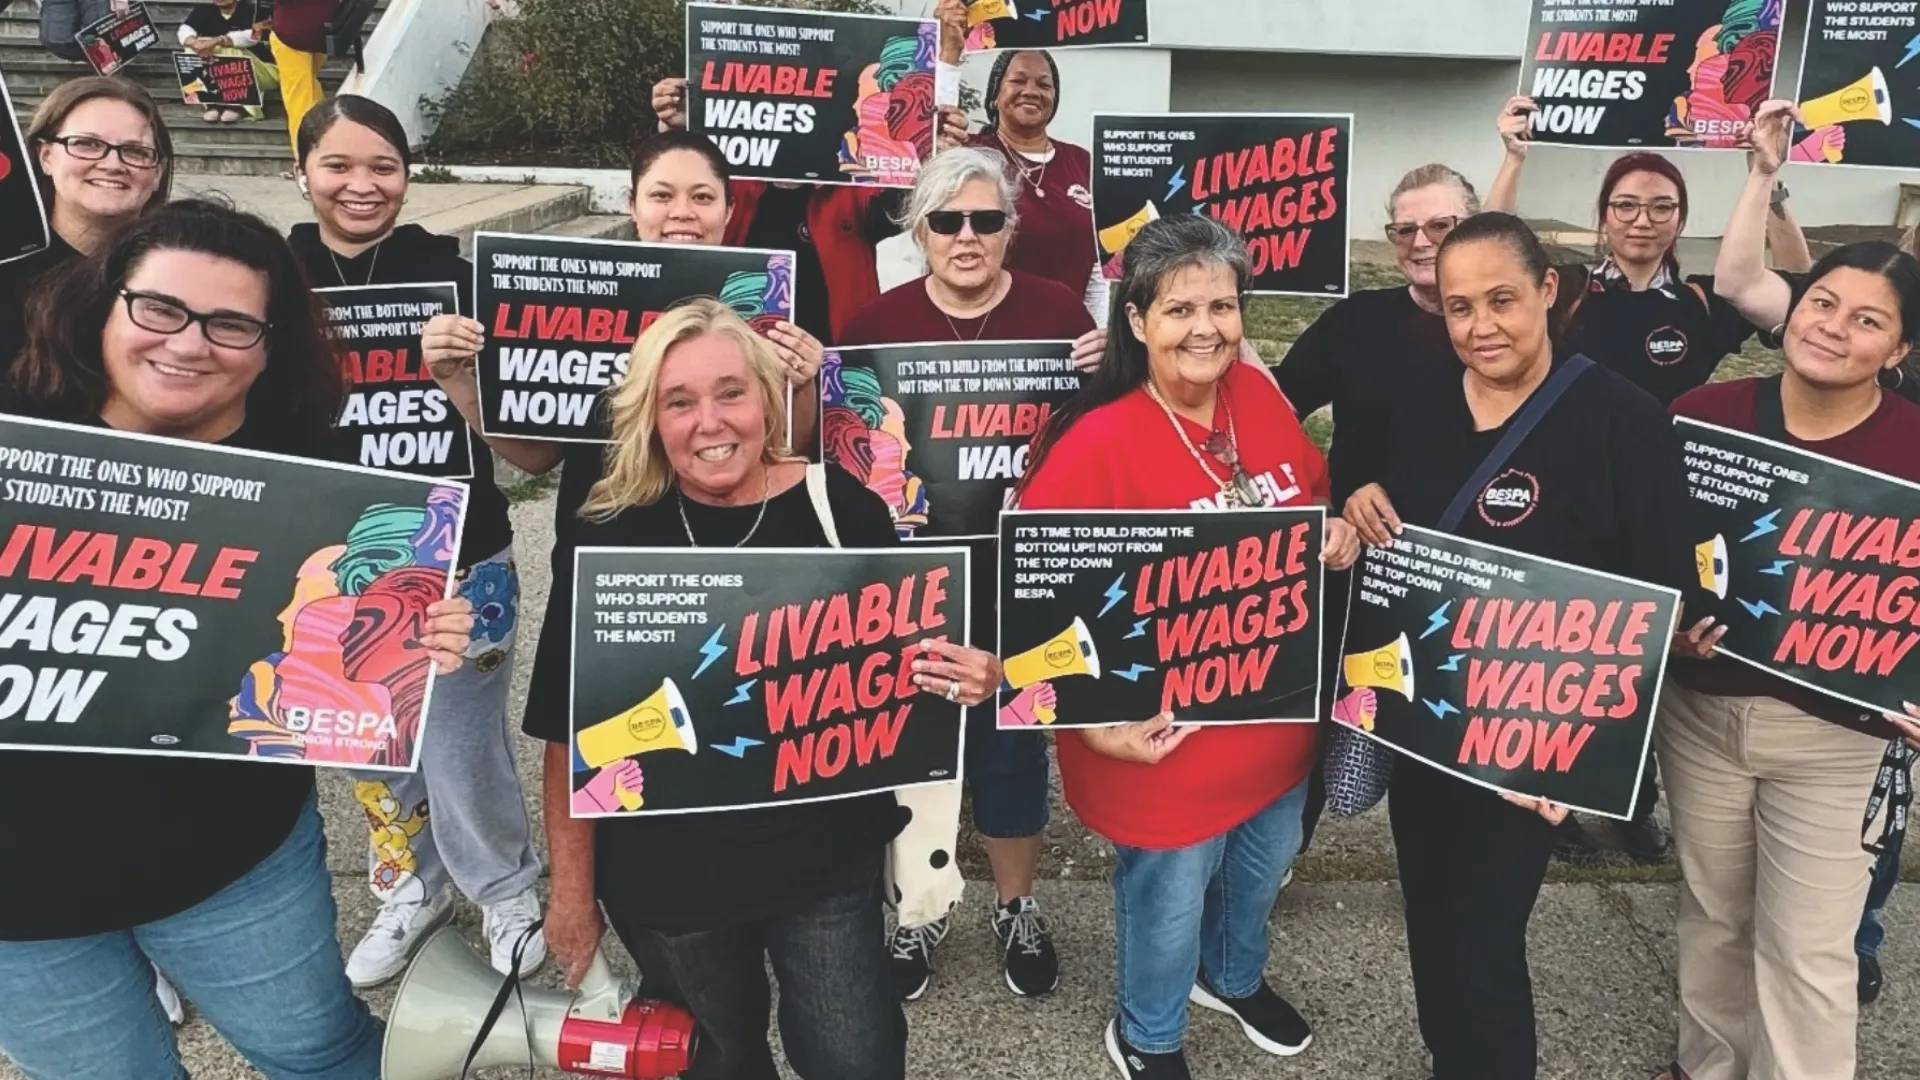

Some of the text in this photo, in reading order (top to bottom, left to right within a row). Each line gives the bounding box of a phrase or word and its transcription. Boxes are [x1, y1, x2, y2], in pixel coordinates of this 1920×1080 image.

[1057, 0, 1121, 41] NOW
[1541, 9, 1638, 22] THE STUDENTS THE MOST!
[1824, 16, 1915, 26] THE STUDENTS
[1827, 2, 1918, 12] WHO SUPPORT
[120, 25, 151, 47] WAGES
[135, 33, 155, 51] NOW
[701, 20, 835, 41] SUPPORT THE ONES WHO SUPPORT
[1822, 29, 1887, 40] THE MOST!
[700, 37, 800, 56] THE STUDENTS THE MOST!
[1535, 32, 1675, 62] LIVABLE
[209, 60, 249, 78] LIVABLE
[217, 74, 253, 89] WAGES
[702, 61, 838, 98] LIVABLE
[223, 88, 247, 102] NOW
[1531, 67, 1646, 100] WAGES
[704, 98, 816, 134] WAGES
[1530, 104, 1605, 135] NOW
[1103, 130, 1195, 140] SUPPORT THE ONES
[1103, 142, 1172, 152] WHO SUPPORT
[707, 135, 780, 167] NOW
[1103, 155, 1173, 165] THE STUDENTS
[1192, 127, 1338, 200] LIVABLE
[1103, 166, 1152, 177] THE MOST!
[1211, 176, 1337, 233] WAGES
[492, 253, 662, 278] SUPPORT THE ONES WHO SUPPORT
[1245, 228, 1311, 276] OW
[492, 274, 618, 296] THE STUDENTS THE MOST!
[354, 305, 375, 320] THE
[377, 303, 421, 317] BOTTOM
[362, 322, 407, 338] SUPPORT
[898, 358, 1063, 375] IT'S TIME TO BUILD FROM THE BOTTOM
[898, 376, 1080, 394] NOT FROM THE TOP DOWN SUPPORT BESPA
[339, 389, 447, 426] AGES
[499, 390, 598, 427] NOW
[360, 431, 453, 466] NOW
[958, 445, 1032, 480] WAG
[1684, 441, 1809, 484] SUPPORT THE ONES
[0, 447, 265, 502] PPORT THE ONES WHO SUPPORT
[1713, 464, 1775, 489] SUPPORT
[2, 477, 190, 521] STUDENTS THE MOST!
[1485, 488, 1530, 502] BESPA
[1696, 488, 1738, 509] MOST!
[1701, 475, 1769, 503] STUDENTS
[1015, 527, 1194, 538] IT'S TIME TO BUILD FROM THE
[1778, 507, 1920, 568] LIVAB
[0, 524, 260, 599] IVABLE
[1015, 542, 1163, 553] BOTTOM UP!! NOT FROM
[1015, 558, 1113, 568] THE TOP DOWN
[1133, 521, 1309, 616] LIVABLE
[1365, 561, 1443, 592] THE TOP DOWN
[1366, 547, 1492, 590] BOTTOM UP!! NOT FROM
[1415, 544, 1429, 557] TO
[1430, 548, 1463, 565] BUILD
[1464, 557, 1498, 575] FROM
[1500, 566, 1526, 582] THE
[595, 574, 743, 587] SUPPORT THE ONES
[1015, 573, 1075, 584] SUPPORT
[1362, 576, 1409, 598] SUPPORT
[595, 593, 707, 605] WHO SUPPORT
[1015, 588, 1055, 599] BESPA
[1360, 590, 1390, 608] BESPA
[1788, 563, 1920, 627] WAG
[594, 611, 707, 624] THE STUDENTS
[735, 566, 950, 675] LIVABLE
[1157, 580, 1309, 663] WAGES
[1451, 596, 1657, 656] LIVABLE
[594, 630, 675, 642] THE MOST!
[1773, 618, 1920, 677] NOW
[765, 634, 948, 734] WAGE
[1161, 644, 1279, 713] NOW
[1466, 658, 1642, 719] WAGES
[0, 664, 108, 723] OW
[286, 706, 397, 739] BESPA
[774, 703, 912, 793] NOW
[1457, 716, 1596, 773] NOW
